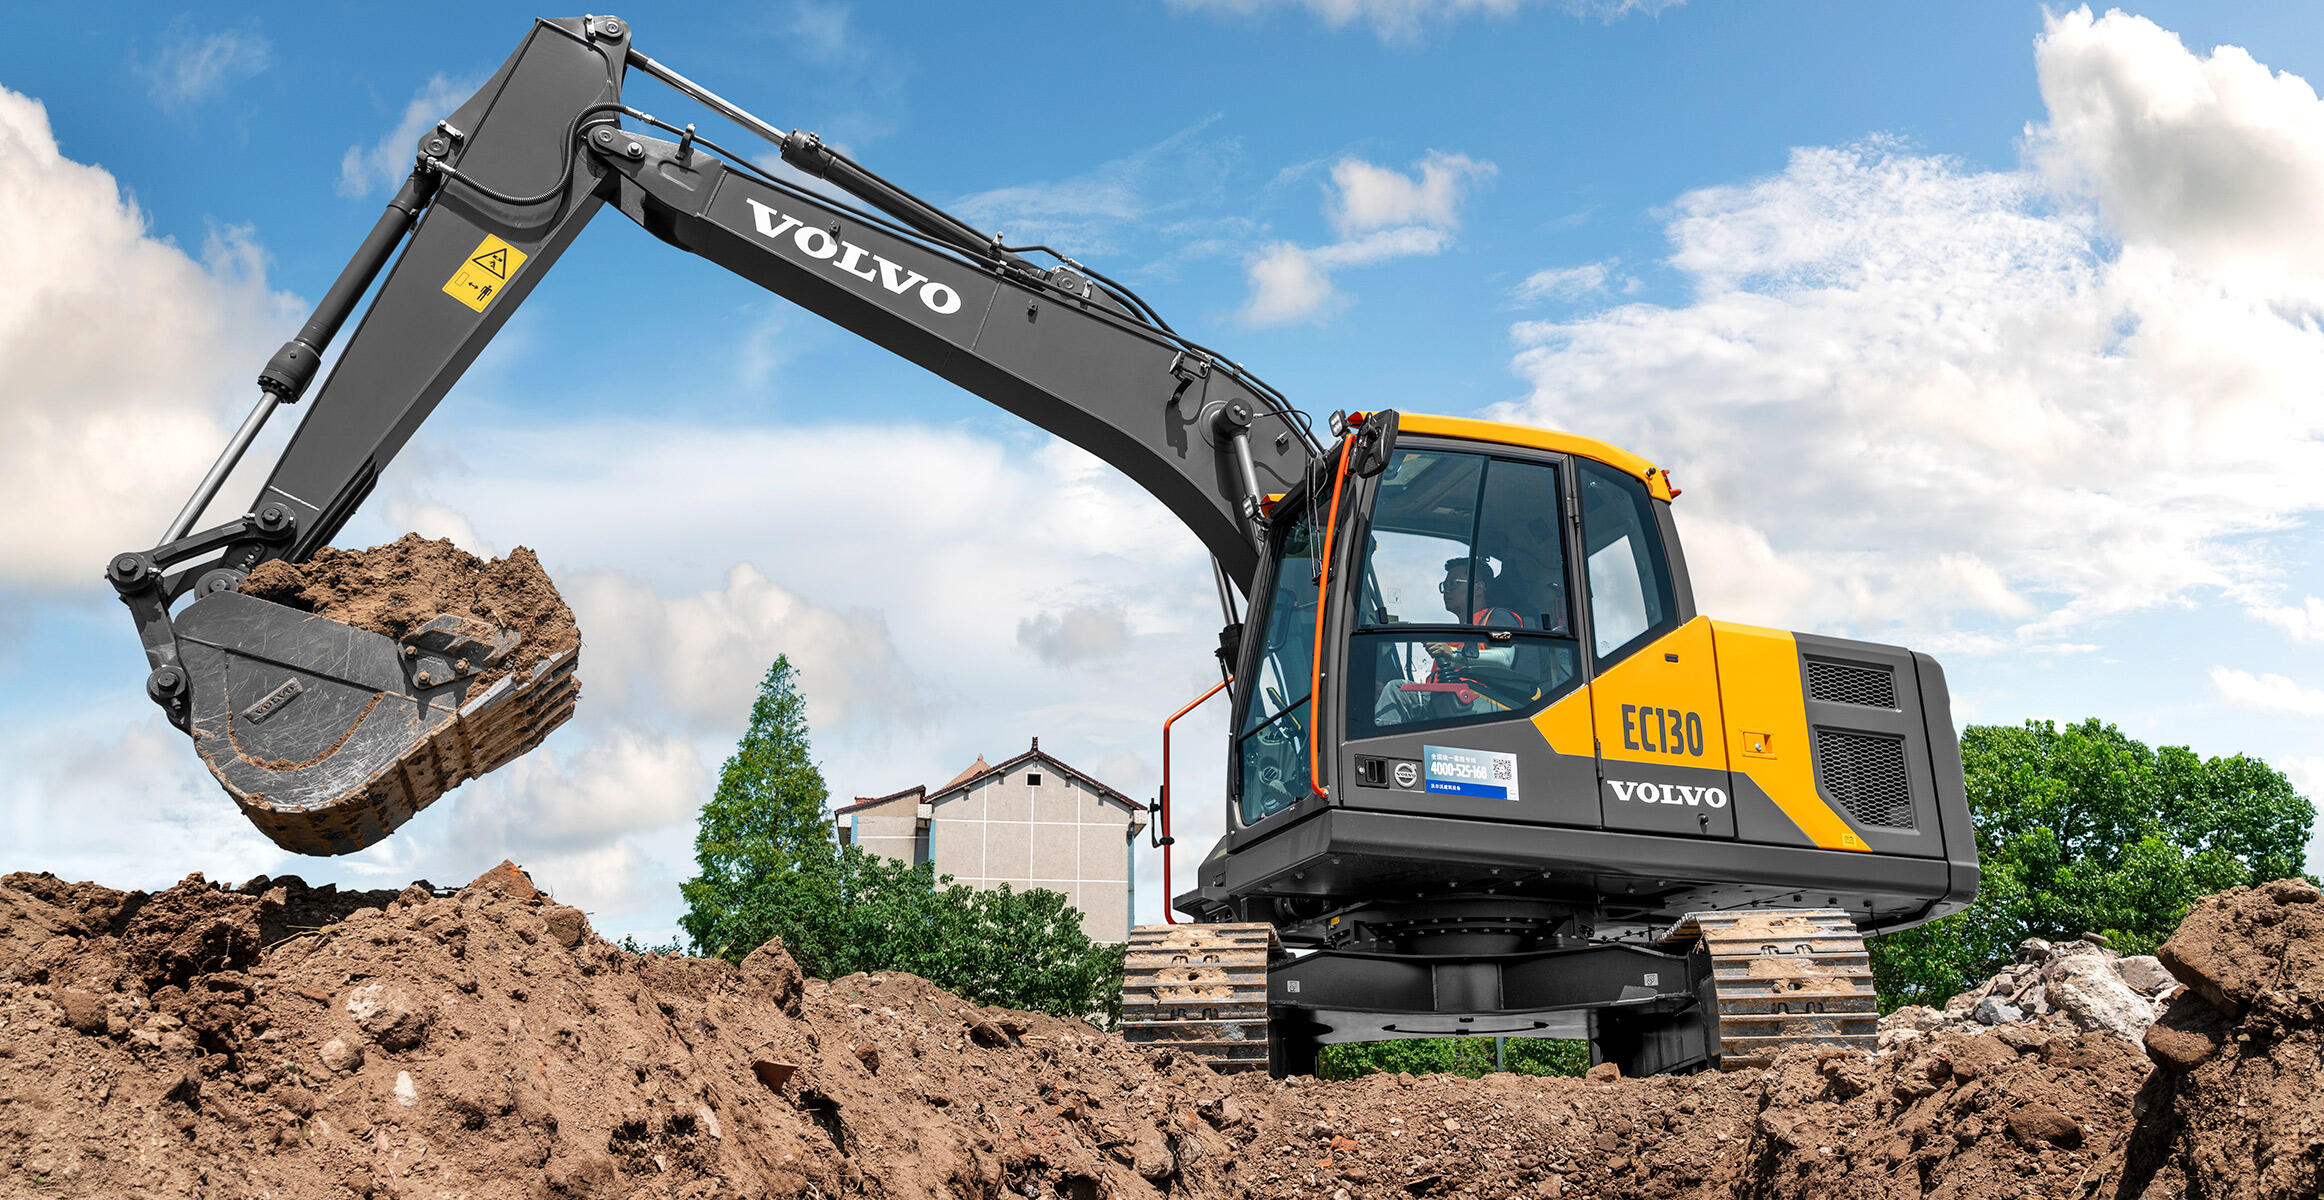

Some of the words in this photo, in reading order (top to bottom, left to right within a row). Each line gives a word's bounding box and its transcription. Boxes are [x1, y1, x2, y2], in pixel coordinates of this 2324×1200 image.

[745, 197, 963, 315] VOLVO
[252, 684, 298, 717] VOLVO
[1621, 703, 1704, 757] EC130
[1430, 761, 1488, 780] 4000-525-168
[1606, 780, 1728, 809] VOLVO
